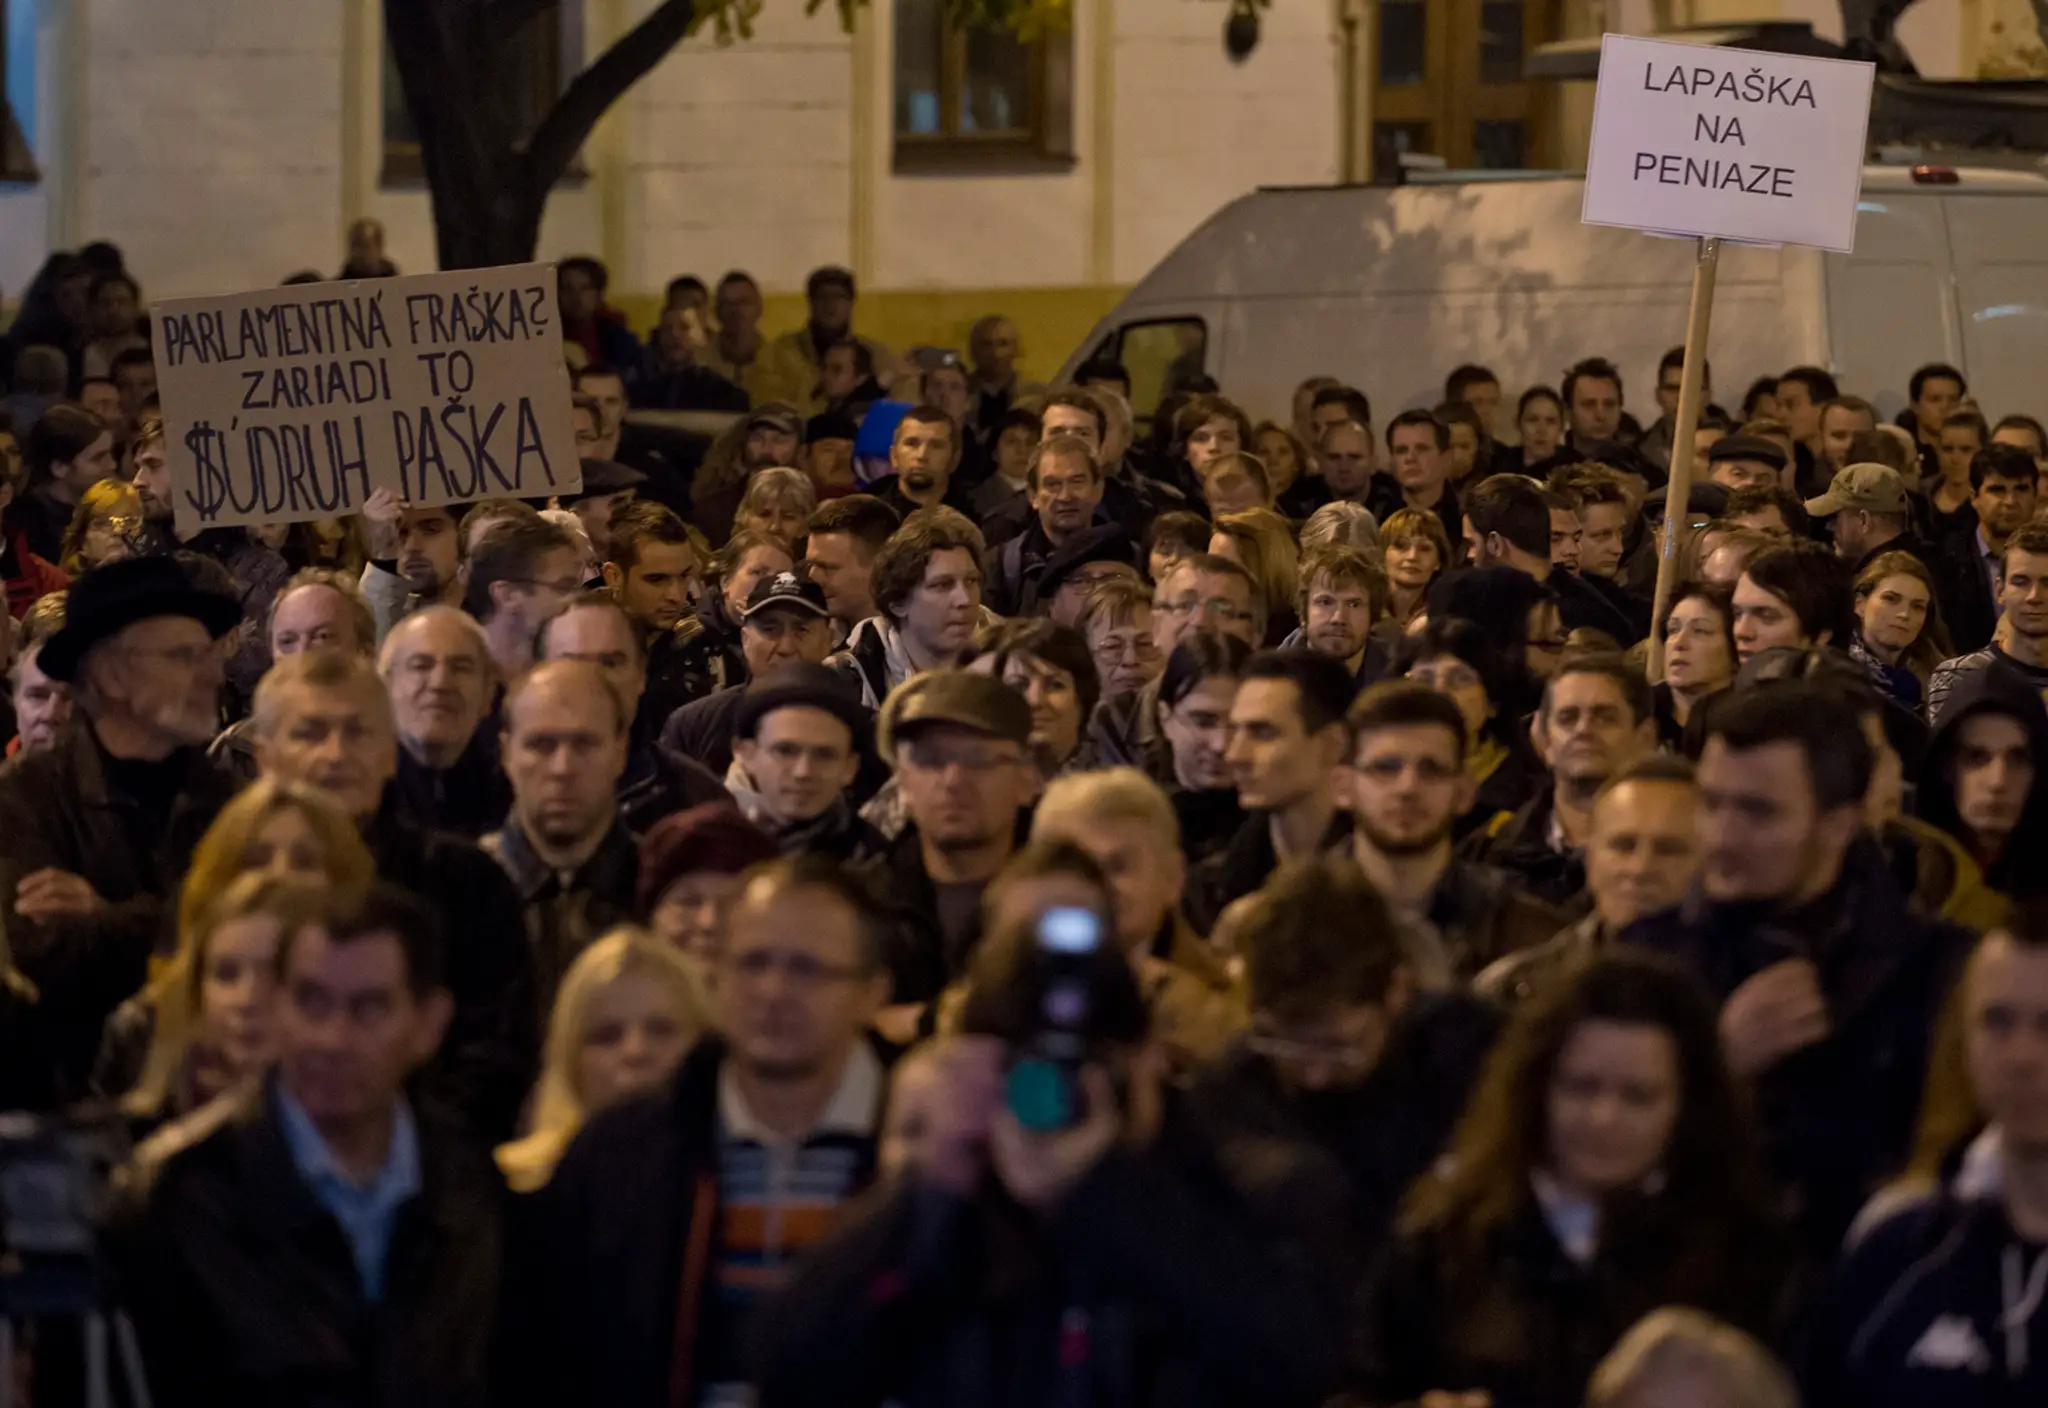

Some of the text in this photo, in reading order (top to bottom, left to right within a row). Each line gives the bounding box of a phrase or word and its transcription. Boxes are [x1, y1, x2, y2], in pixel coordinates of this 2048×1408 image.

[1644, 62, 1816, 108] LAPAŠKA
[1694, 113, 1746, 146] NA
[1633, 152, 1795, 197] PENIAZE
[162, 286, 549, 366] PARLAMENTNÁ FRAŠKA?
[241, 350, 474, 410] ZARIADI TO
[393, 395, 556, 502] PAŠKA
